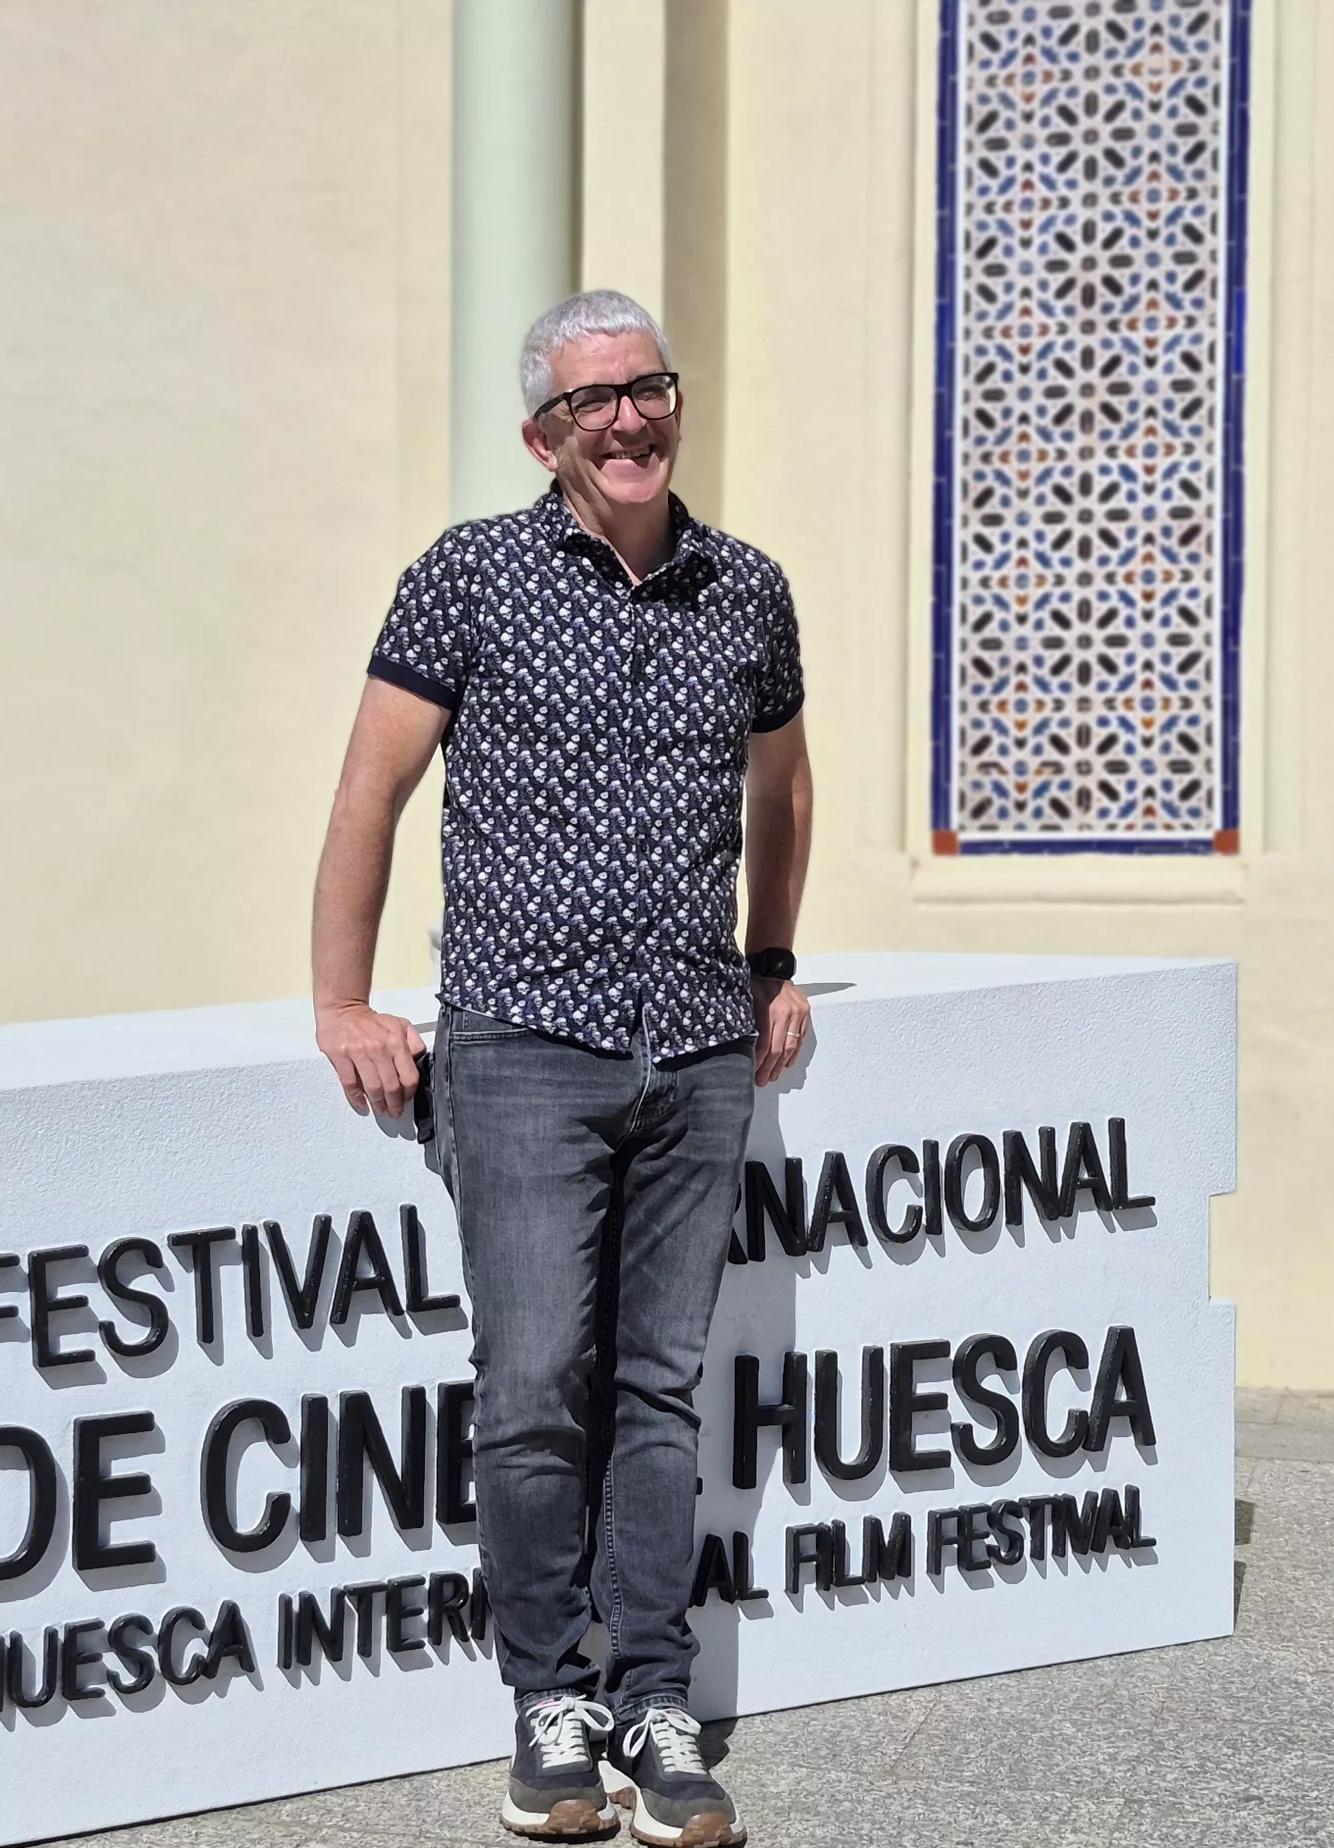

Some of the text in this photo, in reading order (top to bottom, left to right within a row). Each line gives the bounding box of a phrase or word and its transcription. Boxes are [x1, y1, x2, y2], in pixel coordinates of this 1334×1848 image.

[727, 1116, 1157, 1265] NACIONAL
[200, 1379, 477, 1553] CINE
[732, 1324, 1157, 1490] HUESCA
[688, 1530, 769, 1608] AL
[785, 1511, 912, 1595] FILM
[926, 1483, 1157, 1575] FESTIVAL
